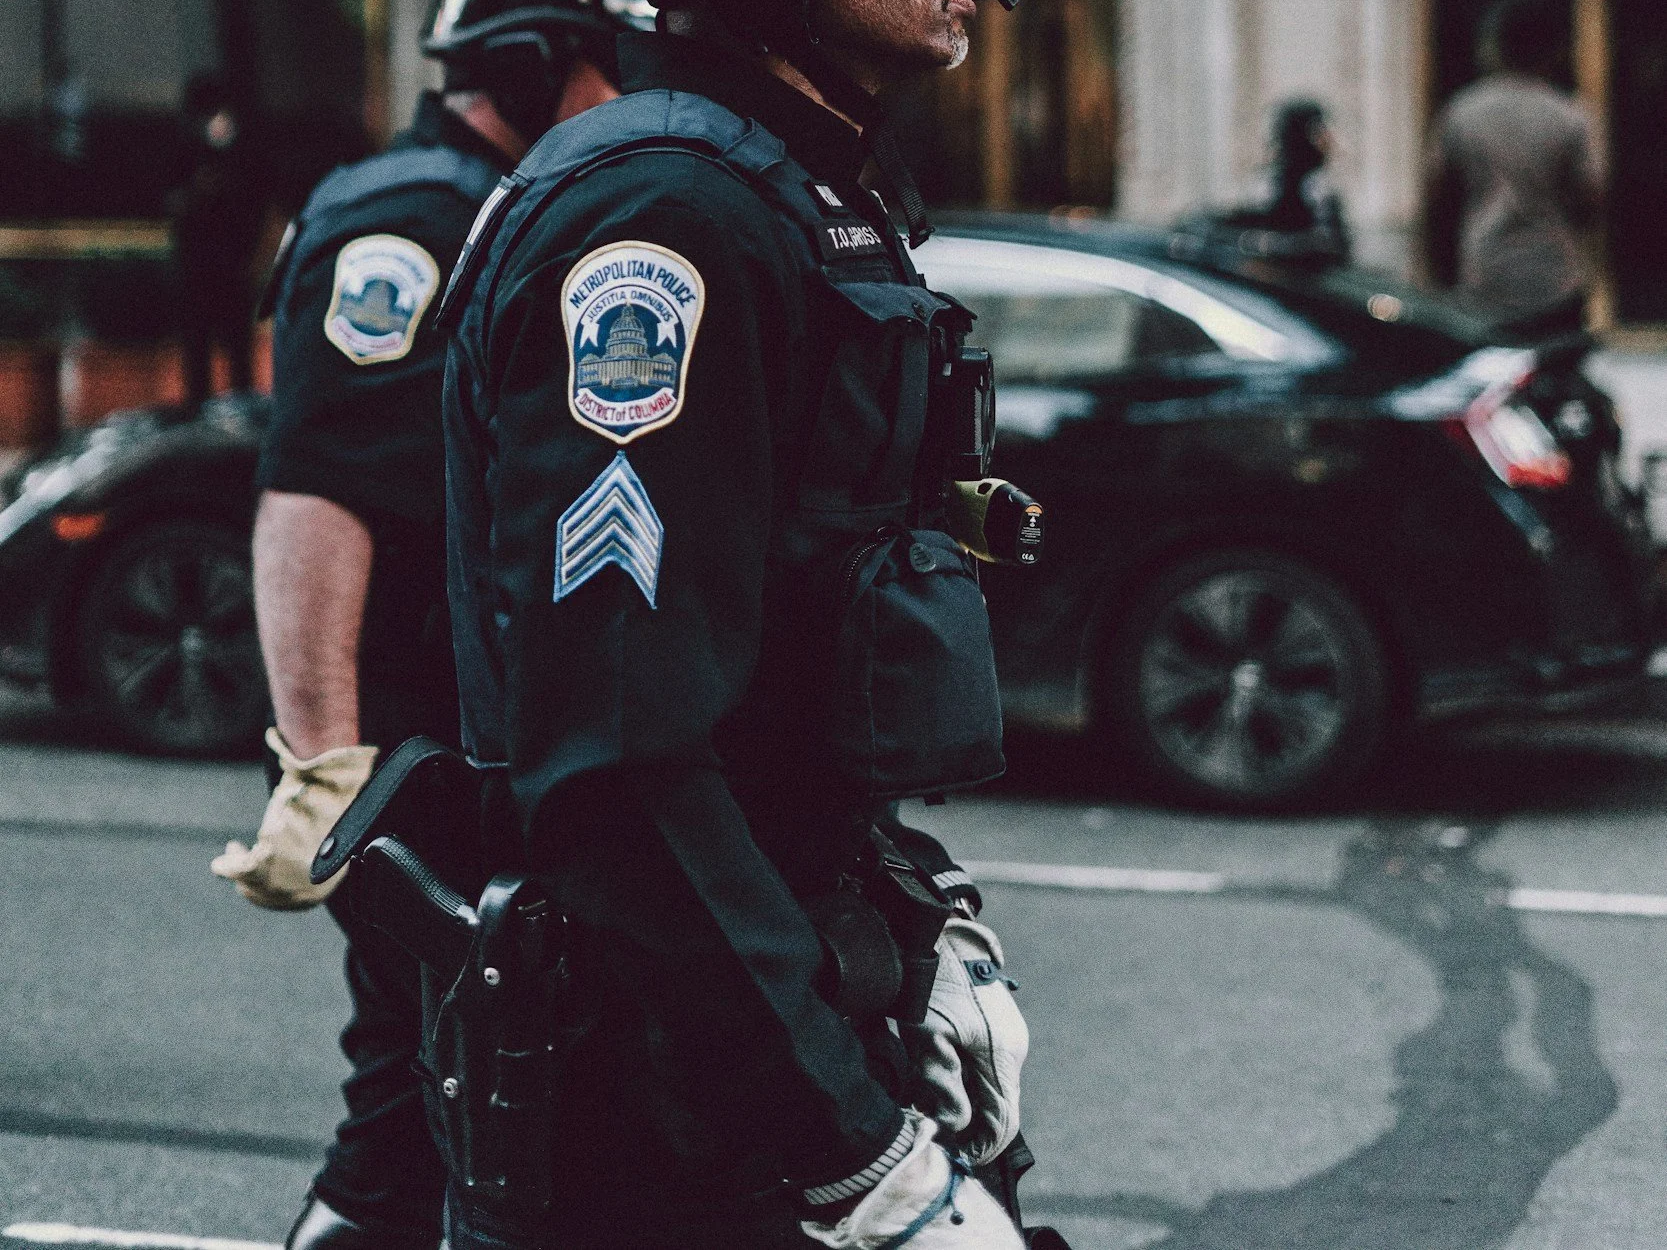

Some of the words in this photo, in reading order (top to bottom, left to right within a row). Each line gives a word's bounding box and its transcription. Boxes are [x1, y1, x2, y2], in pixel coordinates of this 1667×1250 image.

[569, 260, 655, 308] METROPOLITAN
[656, 268, 696, 308] POLICE
[587, 291, 626, 323] JUSTITIA
[631, 291, 673, 322] OMNIBUS
[578, 393, 616, 421] DISTRICT
[616, 409, 626, 421] of
[628, 393, 674, 420] COLUMBIA
